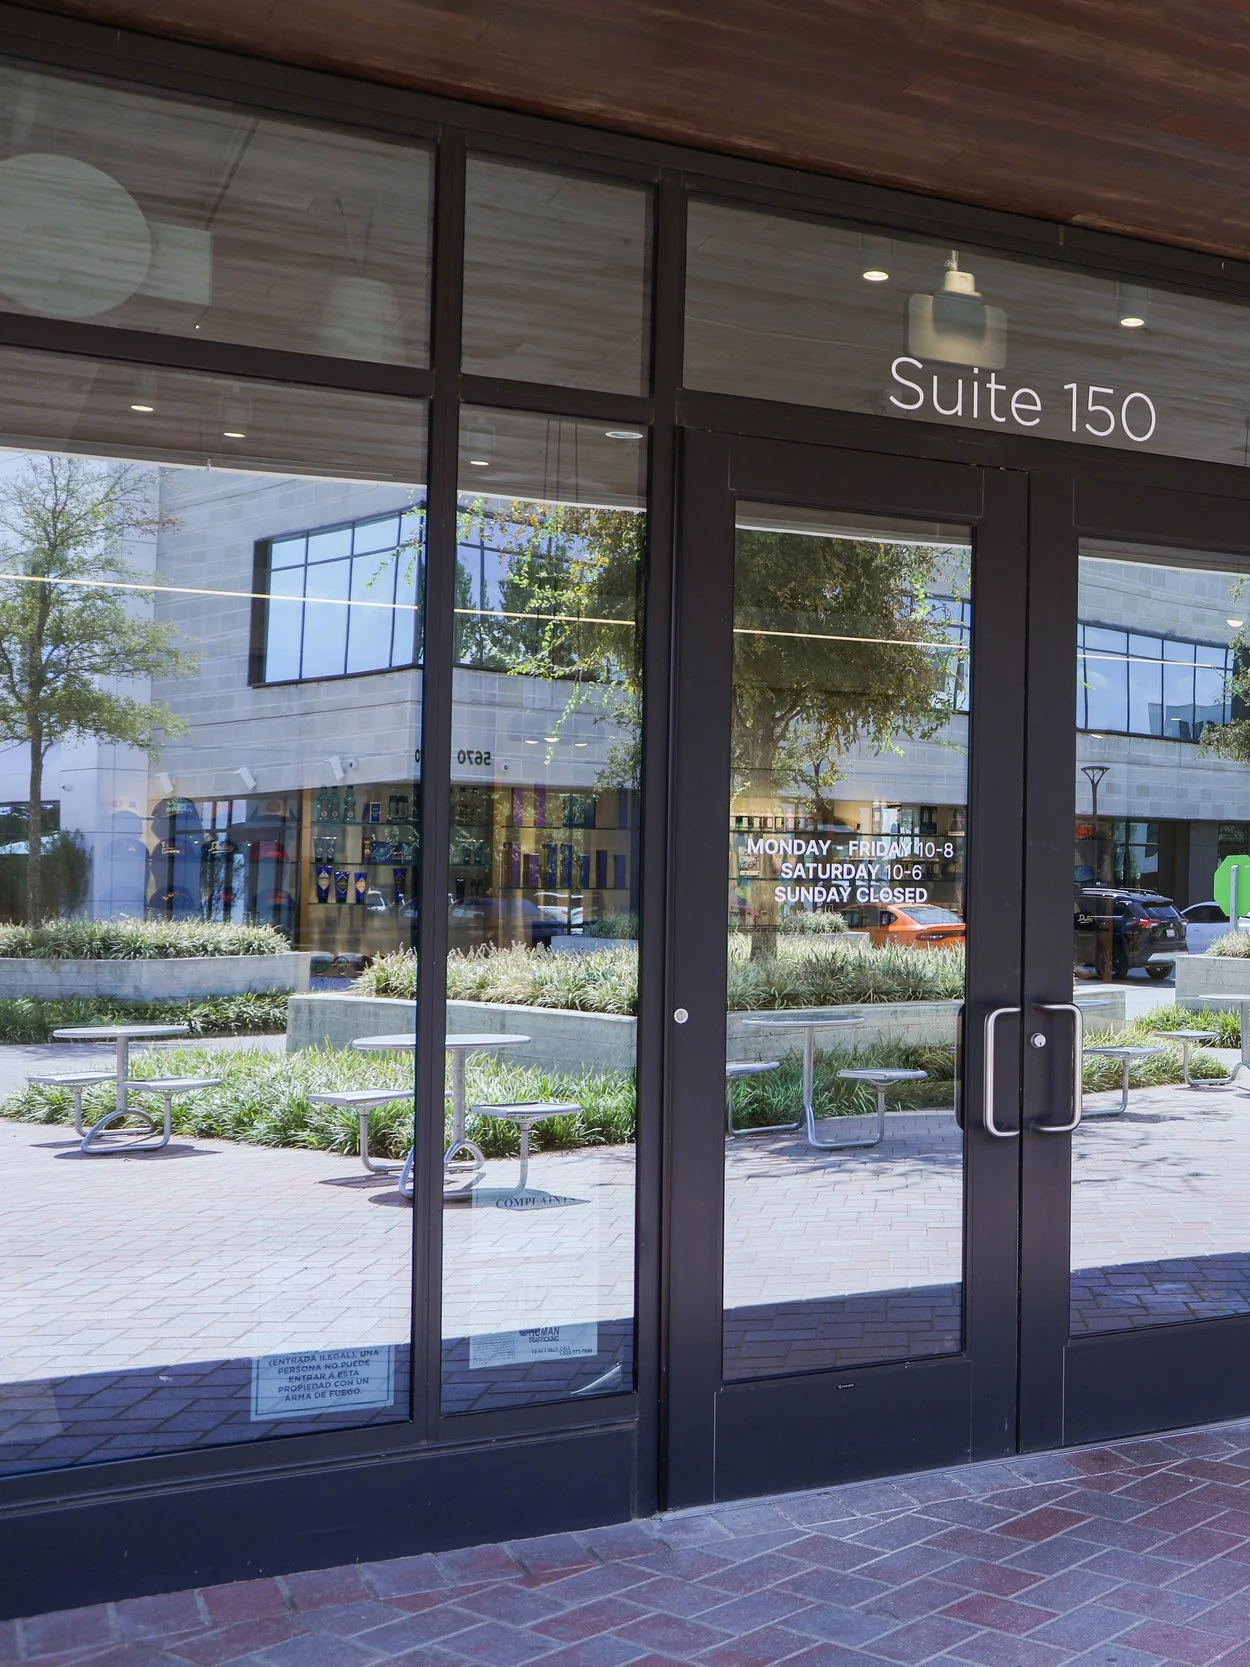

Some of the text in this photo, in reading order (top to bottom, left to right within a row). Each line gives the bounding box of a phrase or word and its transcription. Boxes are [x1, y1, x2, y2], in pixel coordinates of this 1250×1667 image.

[889, 357, 1156, 442] Suite 150
[747, 839, 832, 856] MONDAY
[848, 840, 912, 857] FRIDAY
[917, 842, 954, 858] 10-8
[780, 862, 922, 880] SATURDAY 10-6
[774, 886, 928, 904] SUNDAY CLOSED
[268, 1356, 317, 1367] (ENTRADA
[320, 1352, 358, 1362] ILEGAL),
[360, 1349, 380, 1358] UNA
[277, 1359, 371, 1375] PERSONA NO PUEDE
[278, 1377, 370, 1393] PROPIEDAD CON UN
[288, 1369, 360, 1383] ENTRAR A ESTA
[284, 1387, 363, 1402] ARMA DE FUEGO.
